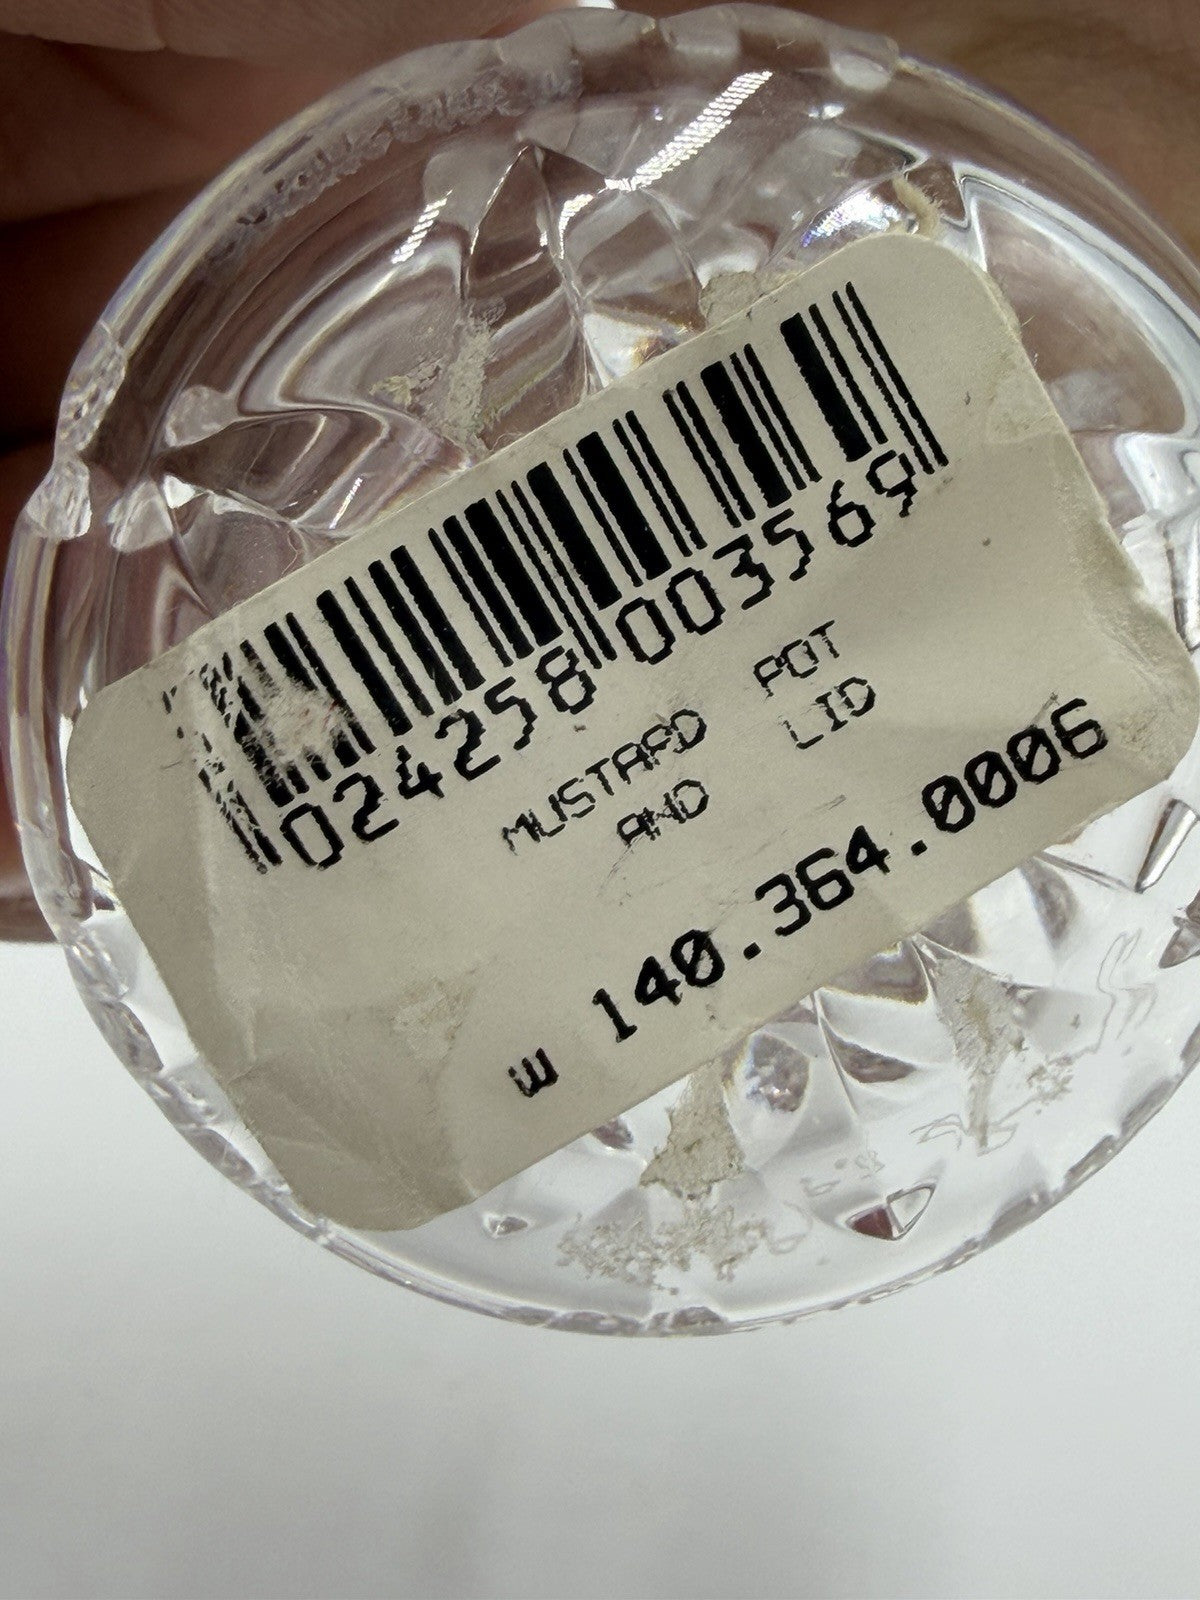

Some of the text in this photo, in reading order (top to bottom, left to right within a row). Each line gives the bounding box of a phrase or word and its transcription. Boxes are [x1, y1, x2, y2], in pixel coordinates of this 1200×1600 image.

[280, 451, 918, 869] 024258 003569
[502, 619, 839, 854] MUSTARD POT
[617, 677, 876, 848] AND LID
[593, 697, 1108, 1043] 140.364.0006
